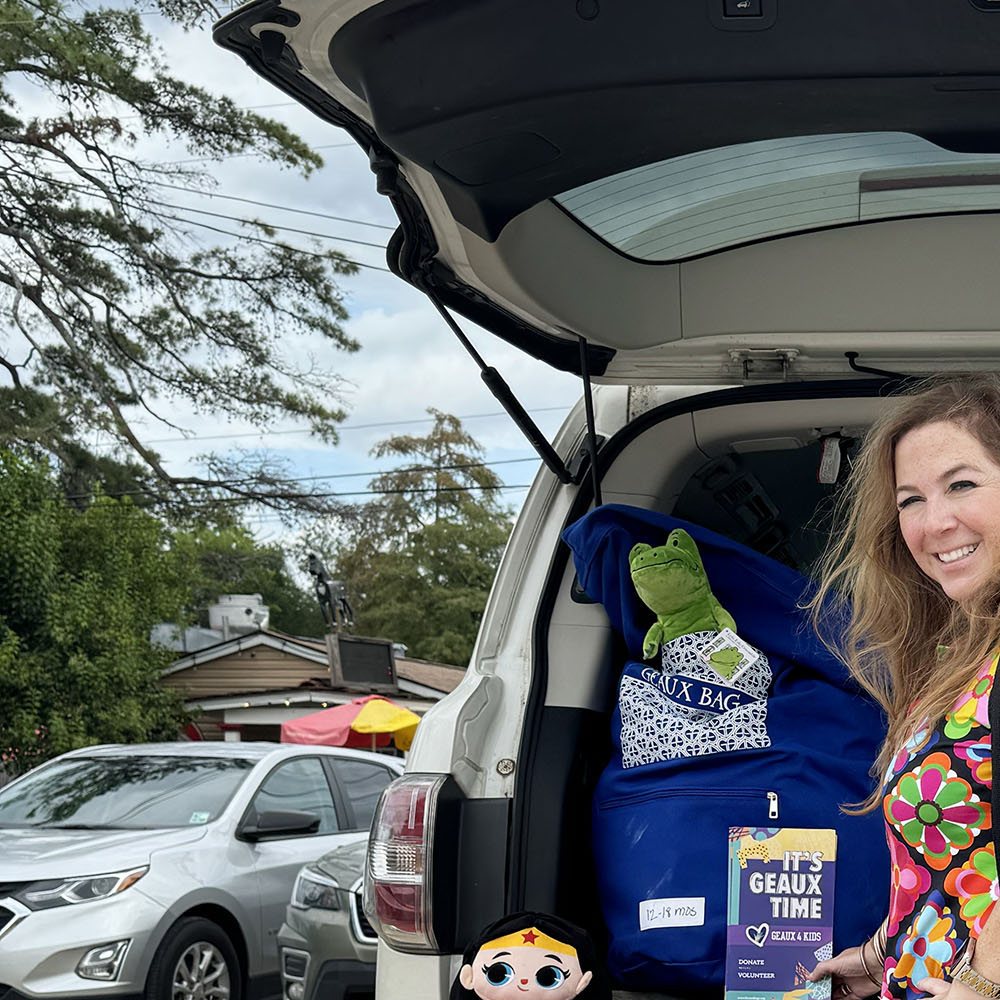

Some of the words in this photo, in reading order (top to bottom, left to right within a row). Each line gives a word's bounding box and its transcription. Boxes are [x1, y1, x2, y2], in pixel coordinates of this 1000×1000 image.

[698, 686, 741, 711] BAG
[782, 850, 824, 873] IT'S
[749, 871, 822, 895] GEAUX
[769, 896, 822, 919] TIME
[771, 931, 796, 941] GEAUX
[796, 931, 802, 941] 4
[803, 931, 821, 941] KIDS
